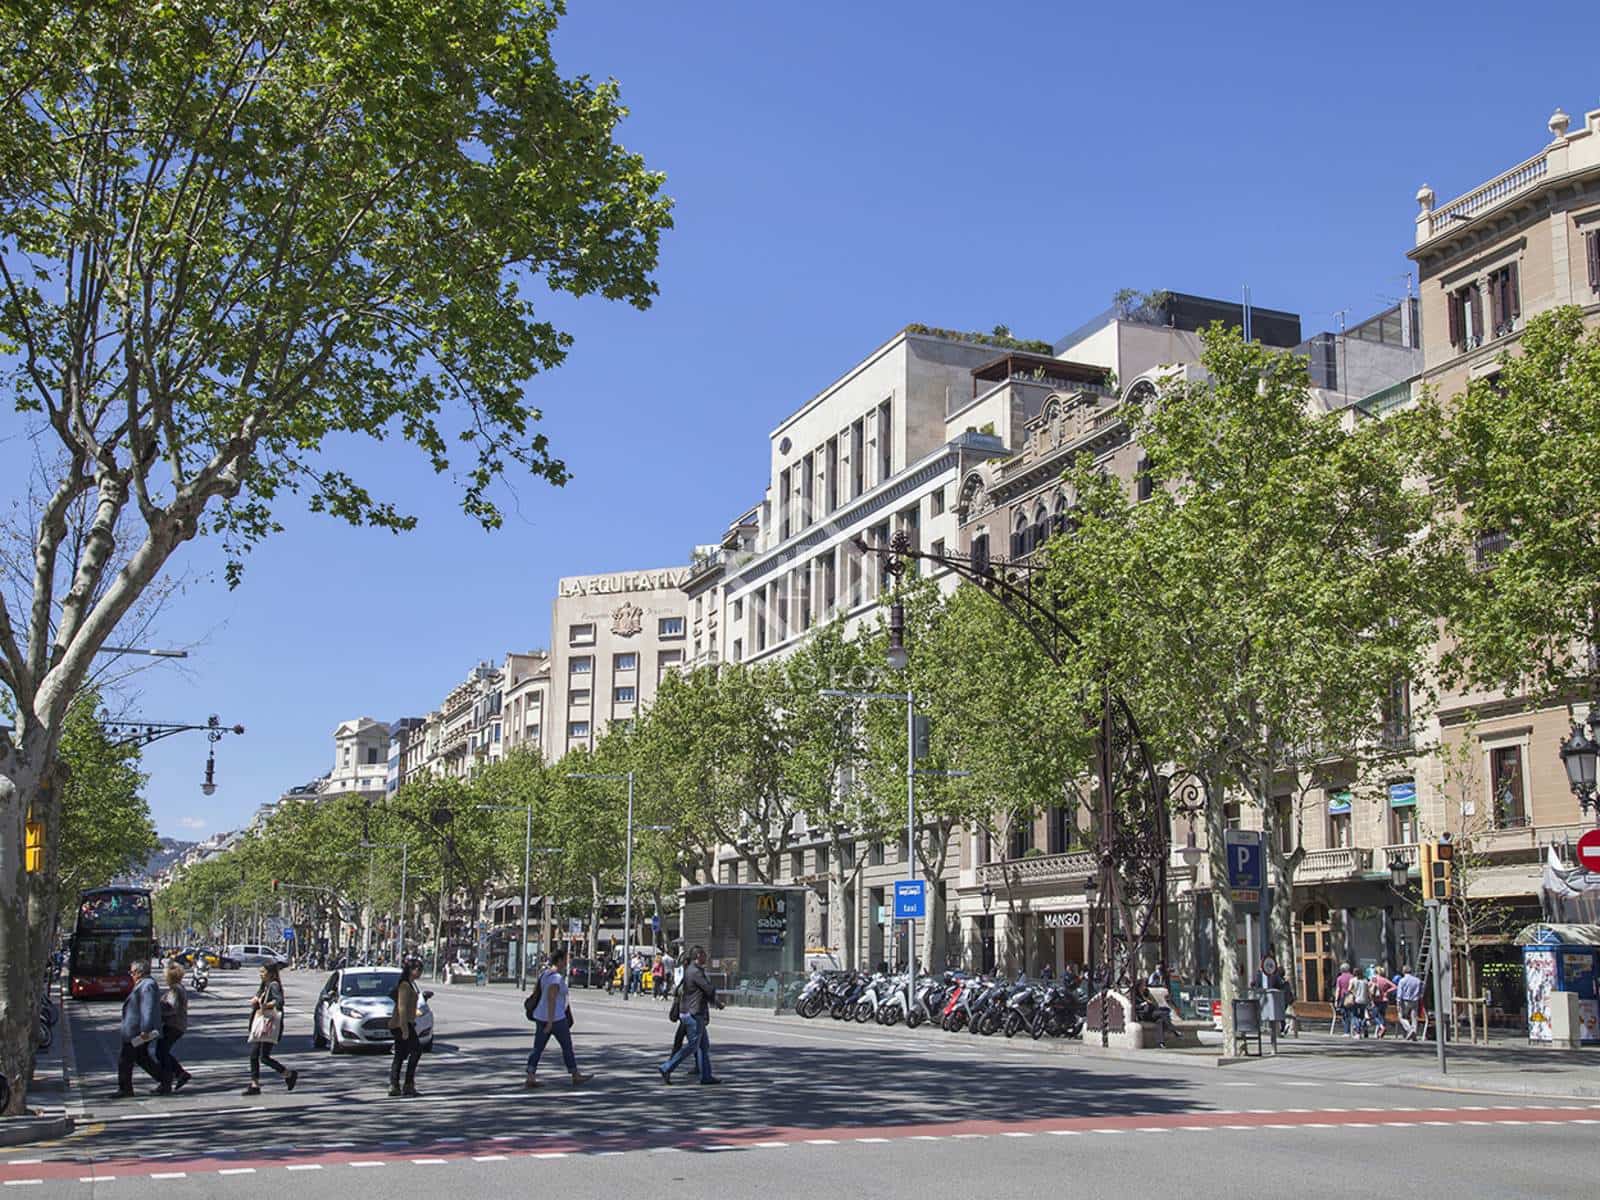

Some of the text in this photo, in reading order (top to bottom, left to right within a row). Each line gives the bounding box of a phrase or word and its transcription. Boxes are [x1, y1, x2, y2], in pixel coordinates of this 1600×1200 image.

[559, 580, 586, 597] LA
[1238, 847, 1250, 872] P
[903, 904, 917, 912] taxi
[1044, 912, 1080, 927] MANGO
